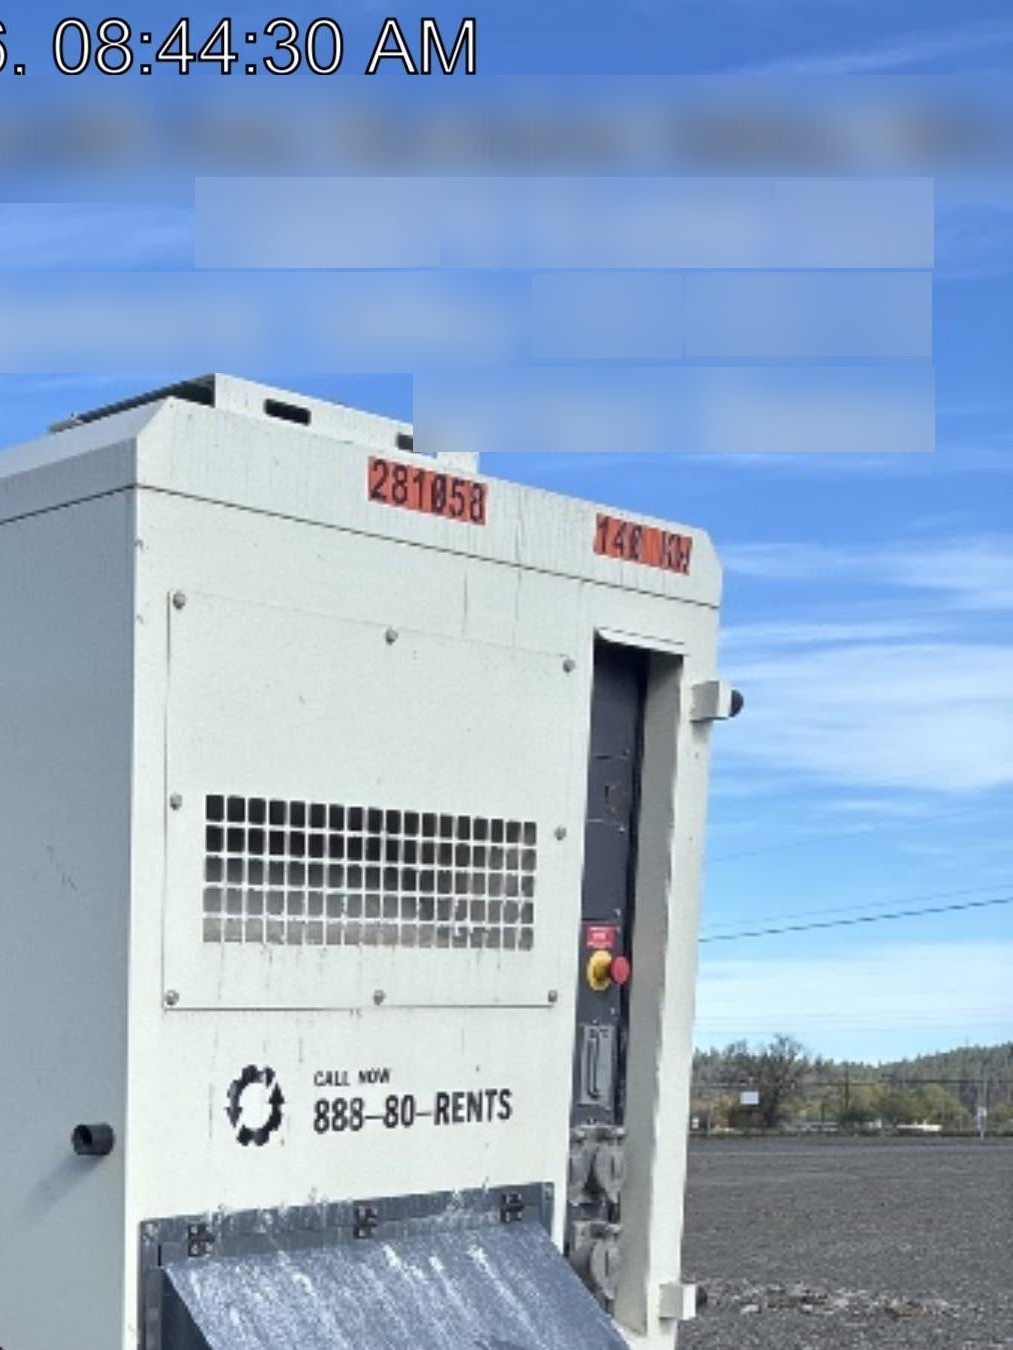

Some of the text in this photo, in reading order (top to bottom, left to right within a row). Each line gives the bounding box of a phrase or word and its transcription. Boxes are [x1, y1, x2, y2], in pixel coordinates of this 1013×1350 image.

[370, 458, 486, 522] 281058
[313, 1067, 392, 1087] CALL NOW
[312, 1088, 514, 1135] 888-80-RENTS
